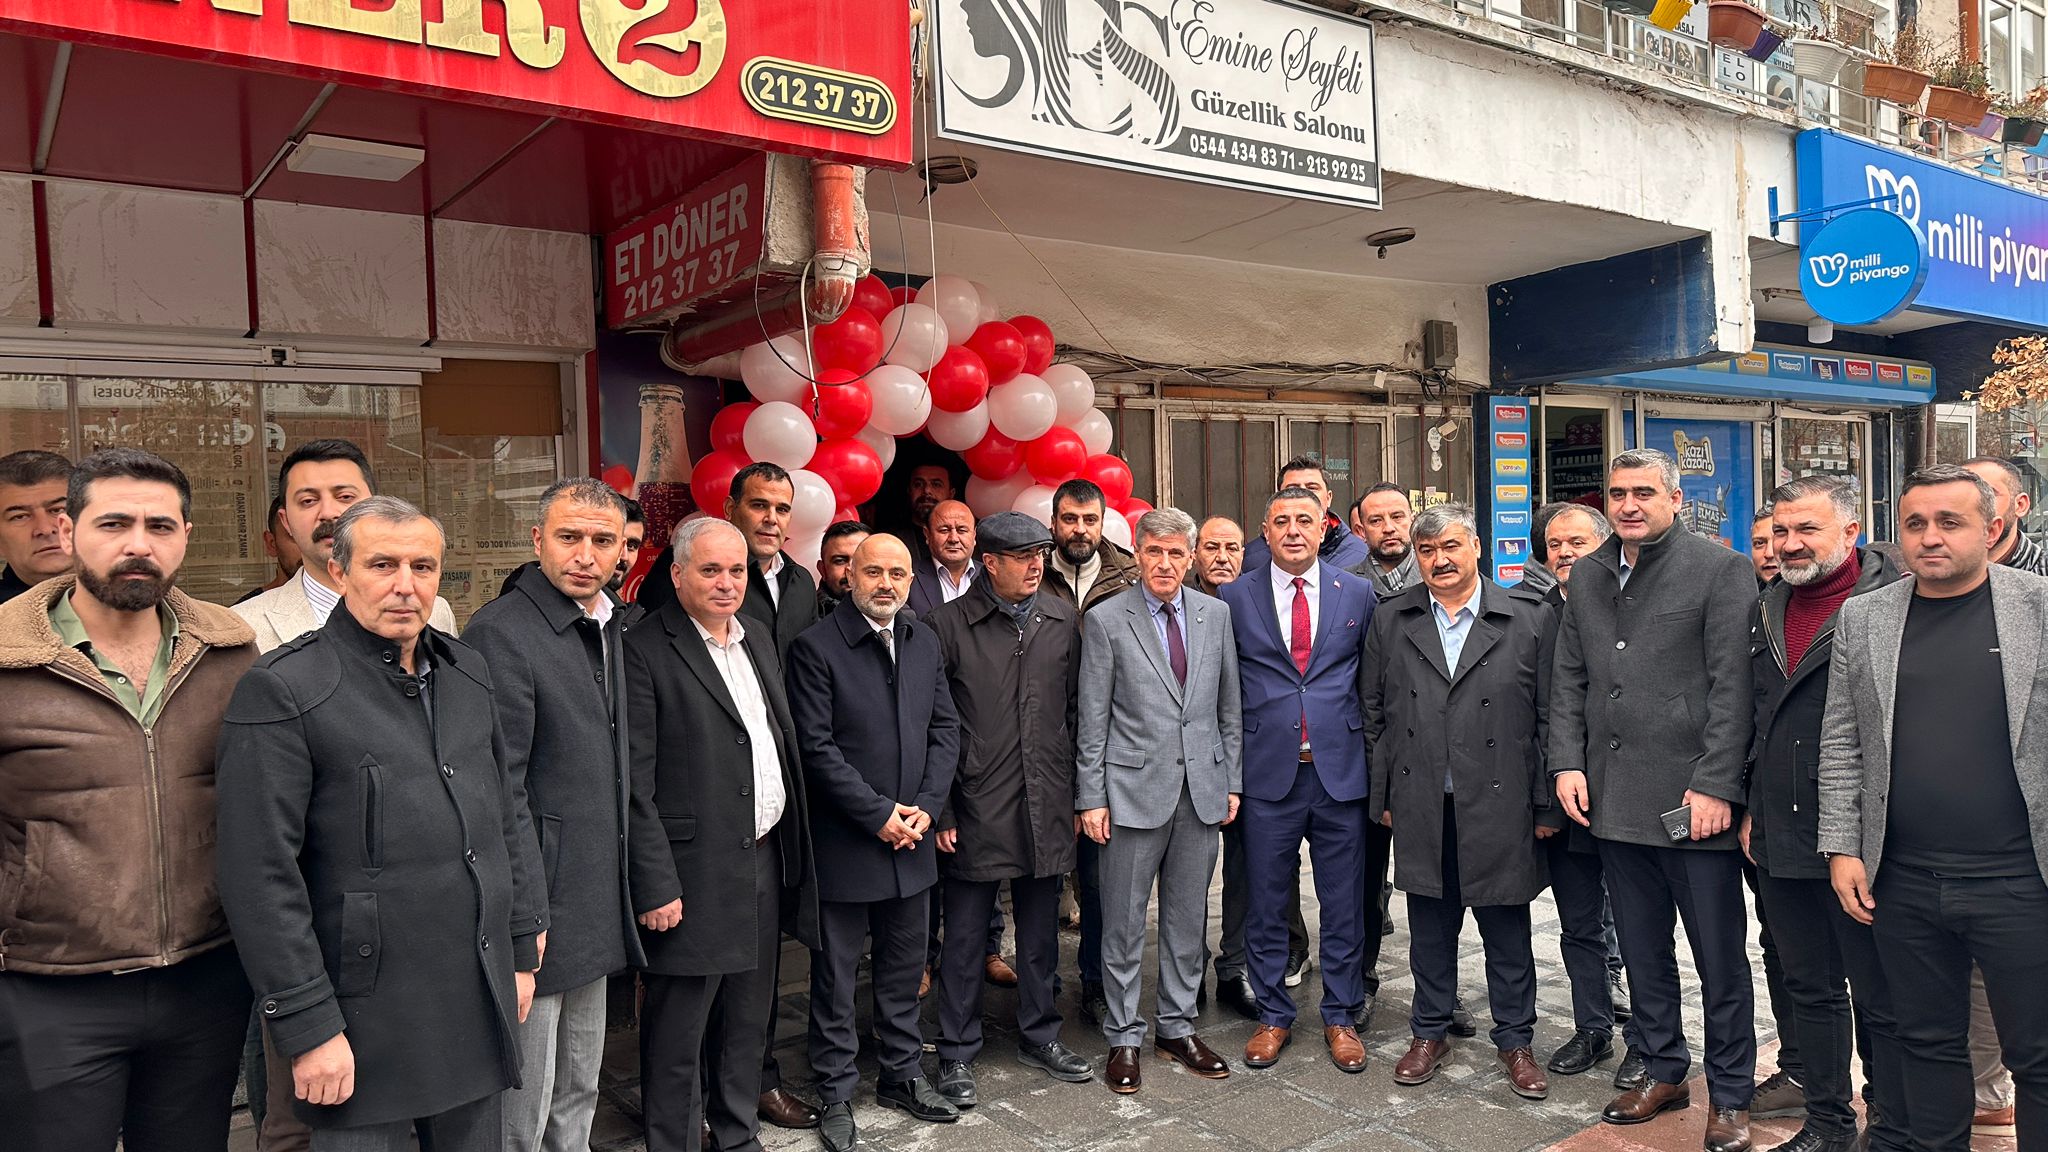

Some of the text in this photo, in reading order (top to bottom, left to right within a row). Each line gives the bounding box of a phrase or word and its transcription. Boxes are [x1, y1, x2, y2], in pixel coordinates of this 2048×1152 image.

[1674, 20, 1695, 36] ASAJ
[1170, 0, 1364, 113] Emine Seyfeli
[758, 71, 881, 120] 212 37 37
[1190, 88, 1367, 145] Güzellik Salonu
[1189, 133, 1227, 158] 0544
[1230, 140, 1258, 164] 434
[1260, 146, 1278, 168] 83
[1280, 150, 1296, 170] 71
[1305, 155, 1329, 176] 213
[1331, 160, 1349, 179] 92
[1350, 164, 1367, 183] 25
[615, 182, 749, 287] ET DÖNER
[1927, 213, 1984, 270] milli
[623, 240, 741, 319] 212 37 37
[1850, 253, 1881, 270] milli
[1850, 264, 1910, 285] piyango
